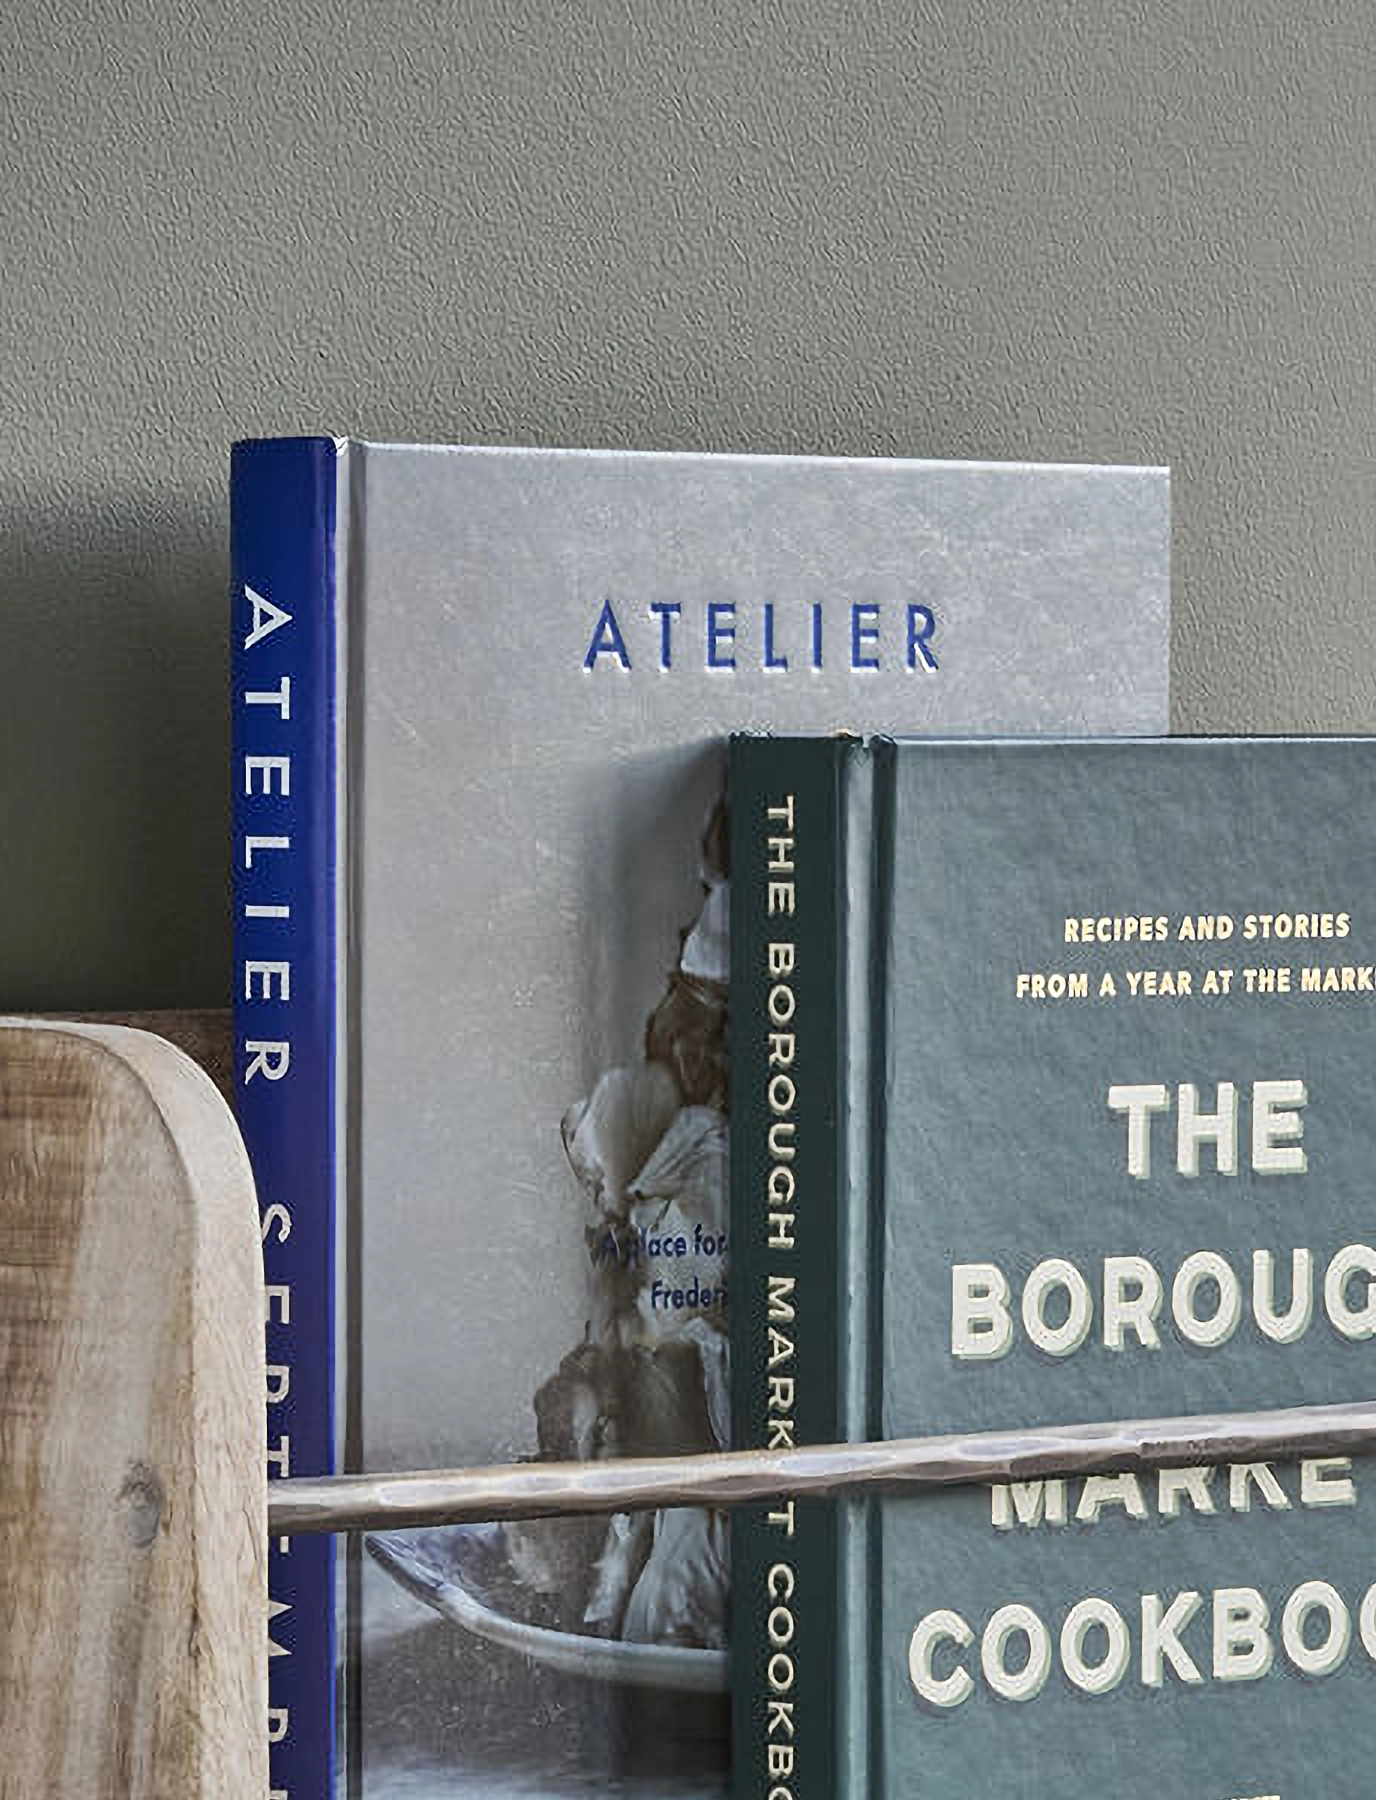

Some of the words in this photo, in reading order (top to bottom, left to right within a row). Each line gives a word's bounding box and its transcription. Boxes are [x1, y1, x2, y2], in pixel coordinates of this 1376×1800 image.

[584, 598, 940, 673] ATELIER
[243, 584, 293, 1086] ATELIER
[766, 795, 797, 915] THE
[1016, 971, 1088, 998] FROM
[1099, 971, 1116, 996] A
[1126, 970, 1191, 995] YEAR
[1203, 969, 1234, 994] AT
[1243, 967, 1291, 993] THE
[1064, 915, 1168, 943] RECIPES
[1178, 914, 1234, 941] AND
[1243, 912, 1352, 939] STORIES
[766, 941, 797, 1251] BOROUGH
[1107, 1079, 1309, 1179] THE
[767, 1275, 797, 1537] MARKT
